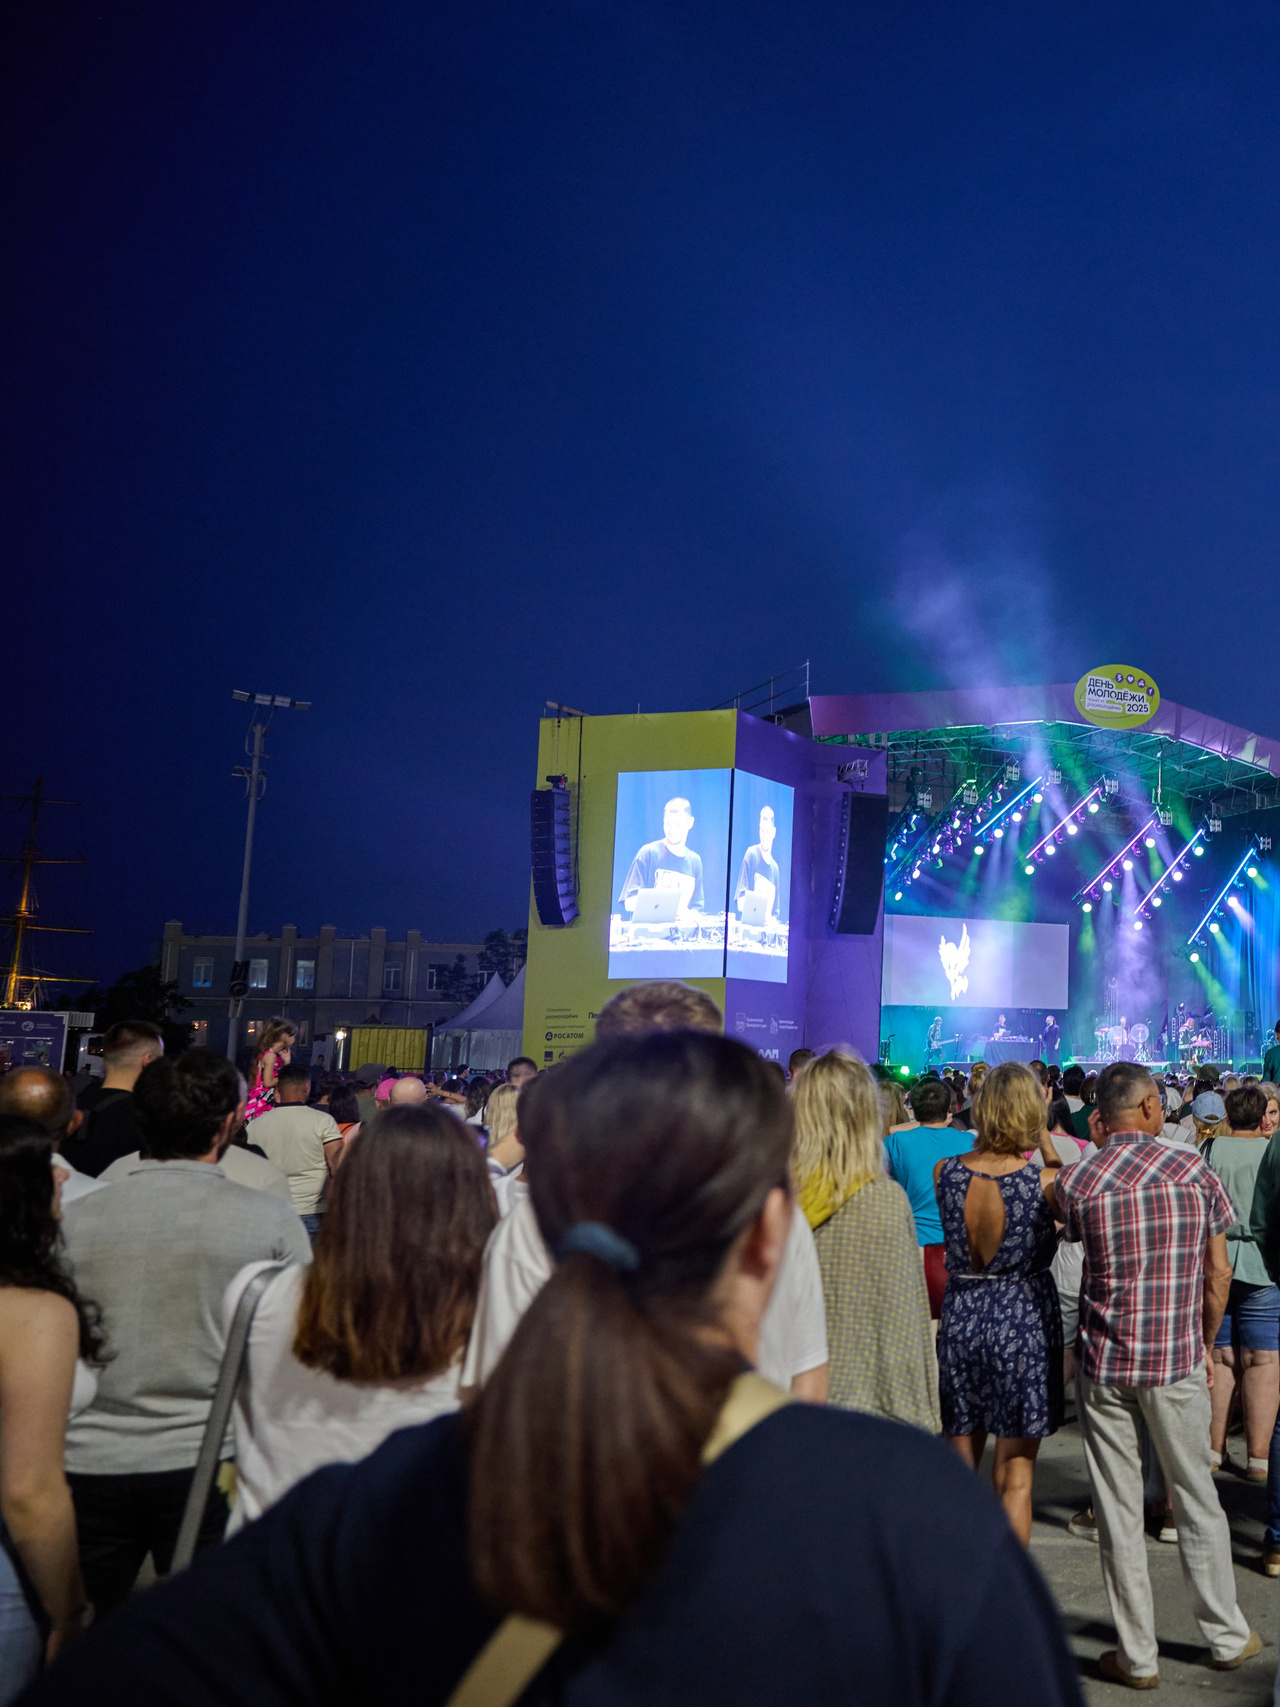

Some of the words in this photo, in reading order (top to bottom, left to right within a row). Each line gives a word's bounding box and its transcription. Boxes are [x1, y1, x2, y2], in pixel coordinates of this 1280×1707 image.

[1088, 677, 1114, 689] ДЕНЬ
[1088, 688, 1145, 703] МОЛОДЁЖИ
[1127, 703, 1149, 713] 2025
